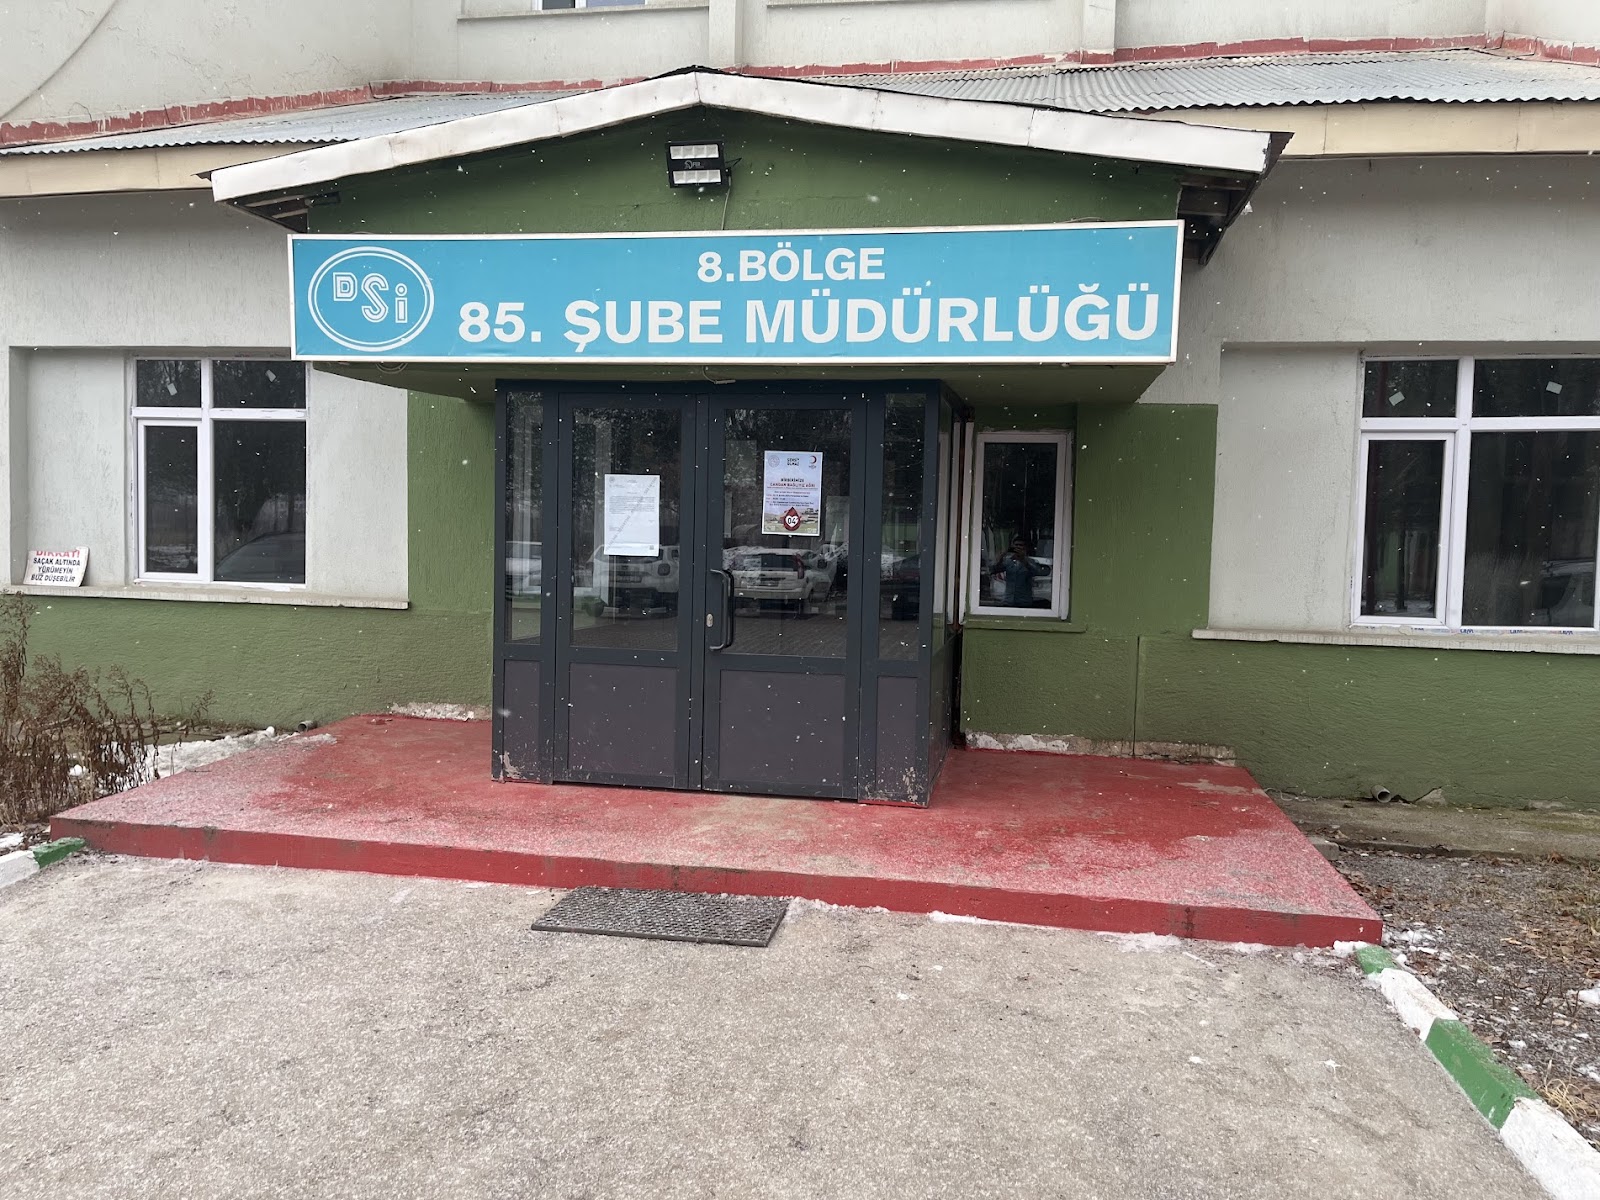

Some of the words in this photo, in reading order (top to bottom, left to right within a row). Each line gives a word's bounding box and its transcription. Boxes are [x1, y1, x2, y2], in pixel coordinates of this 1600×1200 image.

[697, 242, 886, 283] 8.BÖLGE
[458, 301, 542, 344] 85.
[563, 299, 723, 353] ŞUBE
[745, 282, 1159, 344] MÜDÜRLÜĞÜ
[33, 557, 53, 566] SAÇAK
